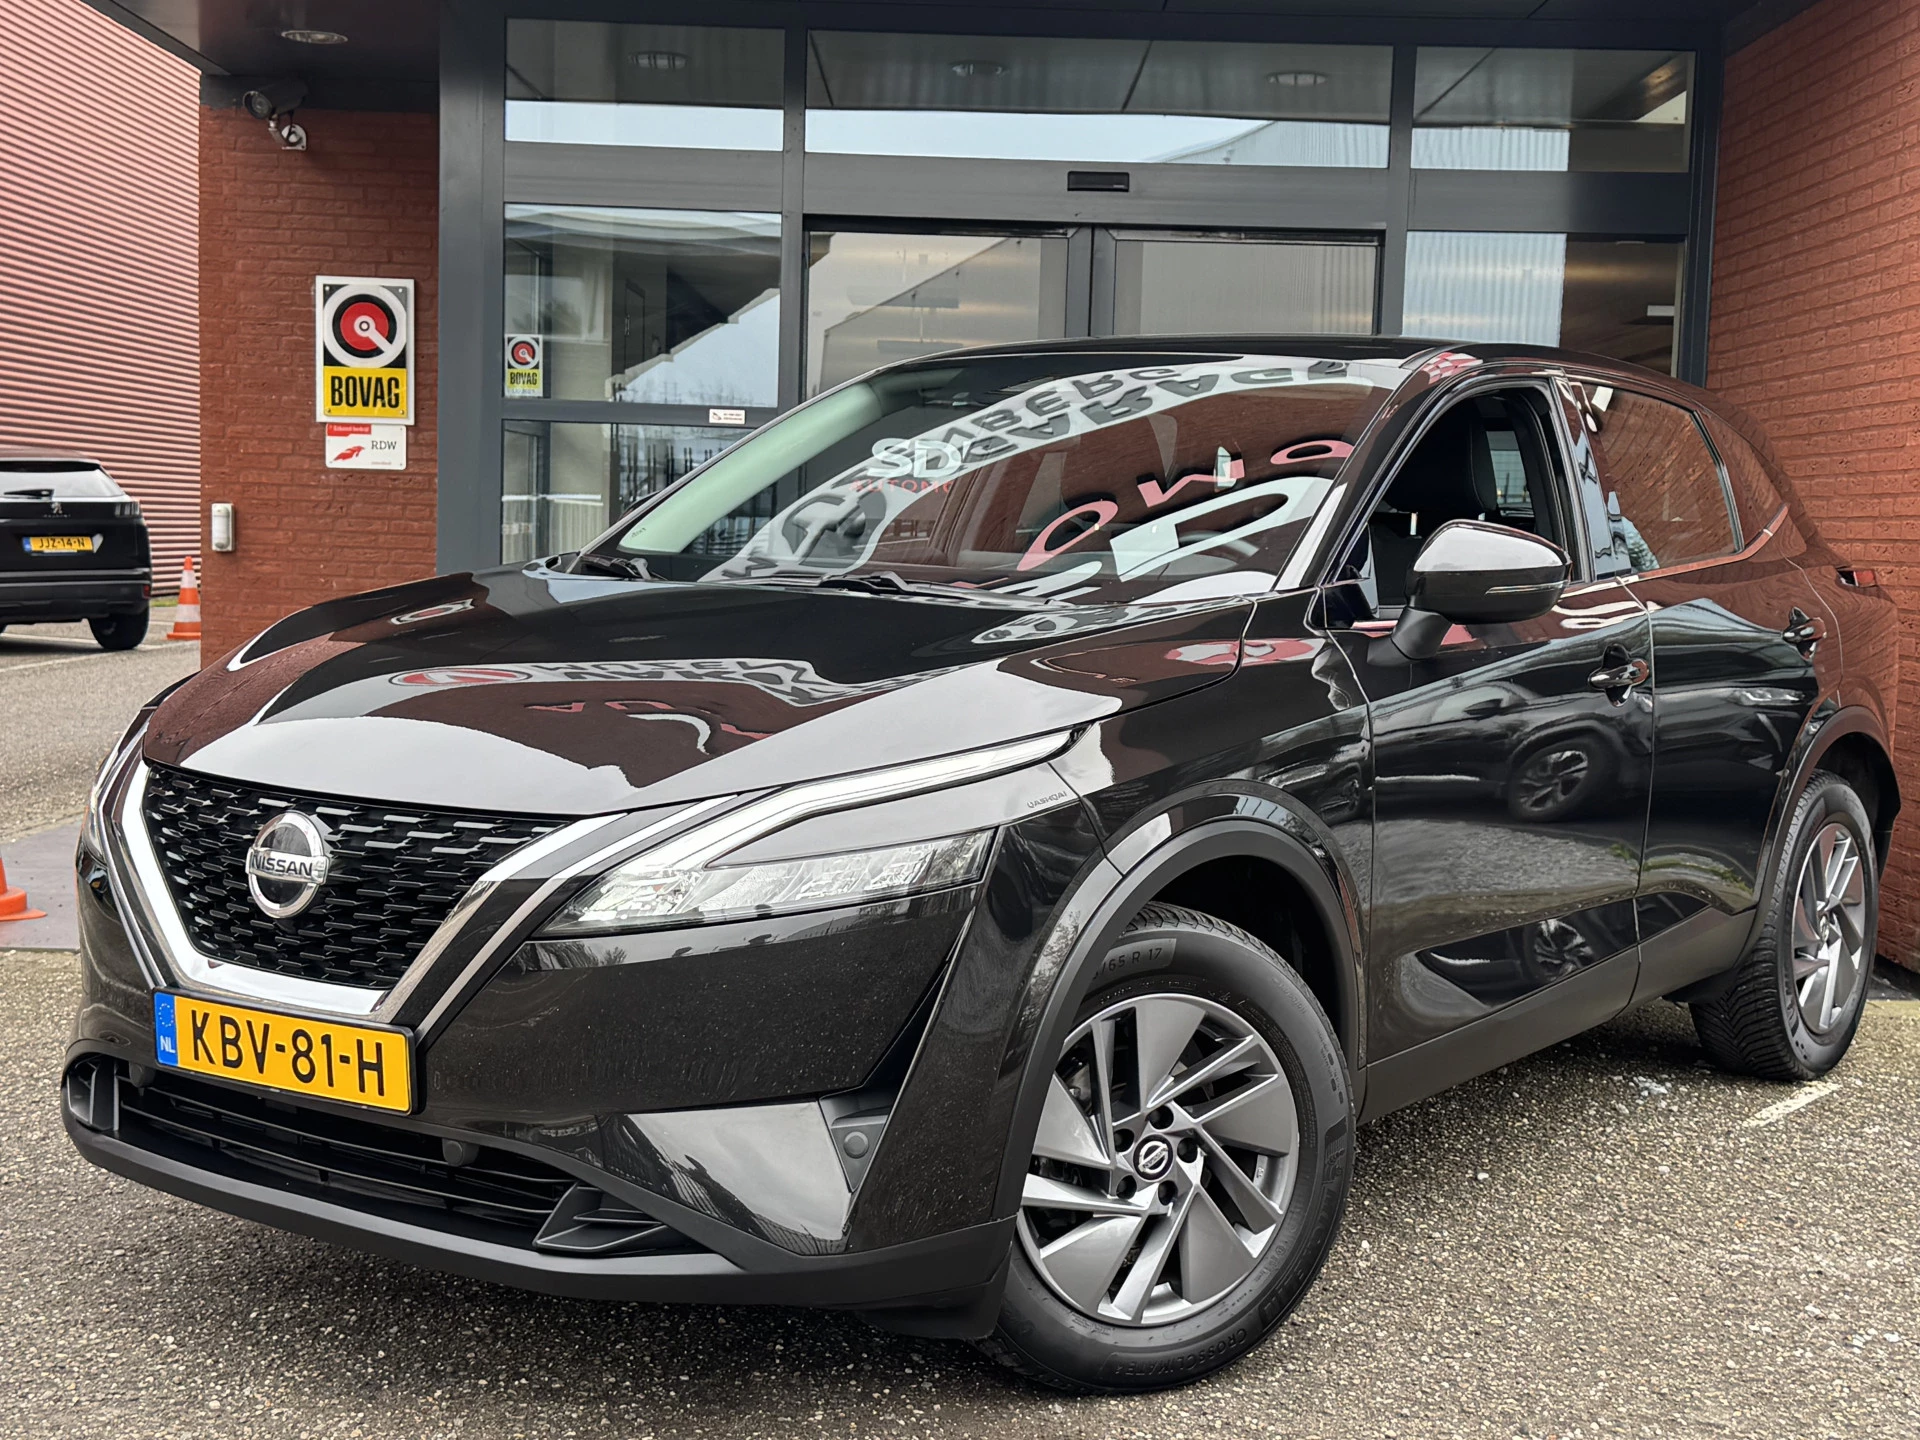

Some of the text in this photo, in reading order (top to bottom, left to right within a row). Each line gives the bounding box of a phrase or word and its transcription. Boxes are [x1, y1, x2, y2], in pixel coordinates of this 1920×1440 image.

[510, 372, 537, 385] BOVAG
[331, 375, 400, 409] BOVAG
[371, 440, 397, 450] RDW
[39, 536, 85, 548] JJZ-14-N
[1027, 791, 1067, 808] QASHQAI
[253, 852, 312, 876] NISSAN
[1092, 948, 1162, 980] /65 R 17
[160, 1035, 175, 1053] NL
[191, 1010, 384, 1096] KBV-81-H
